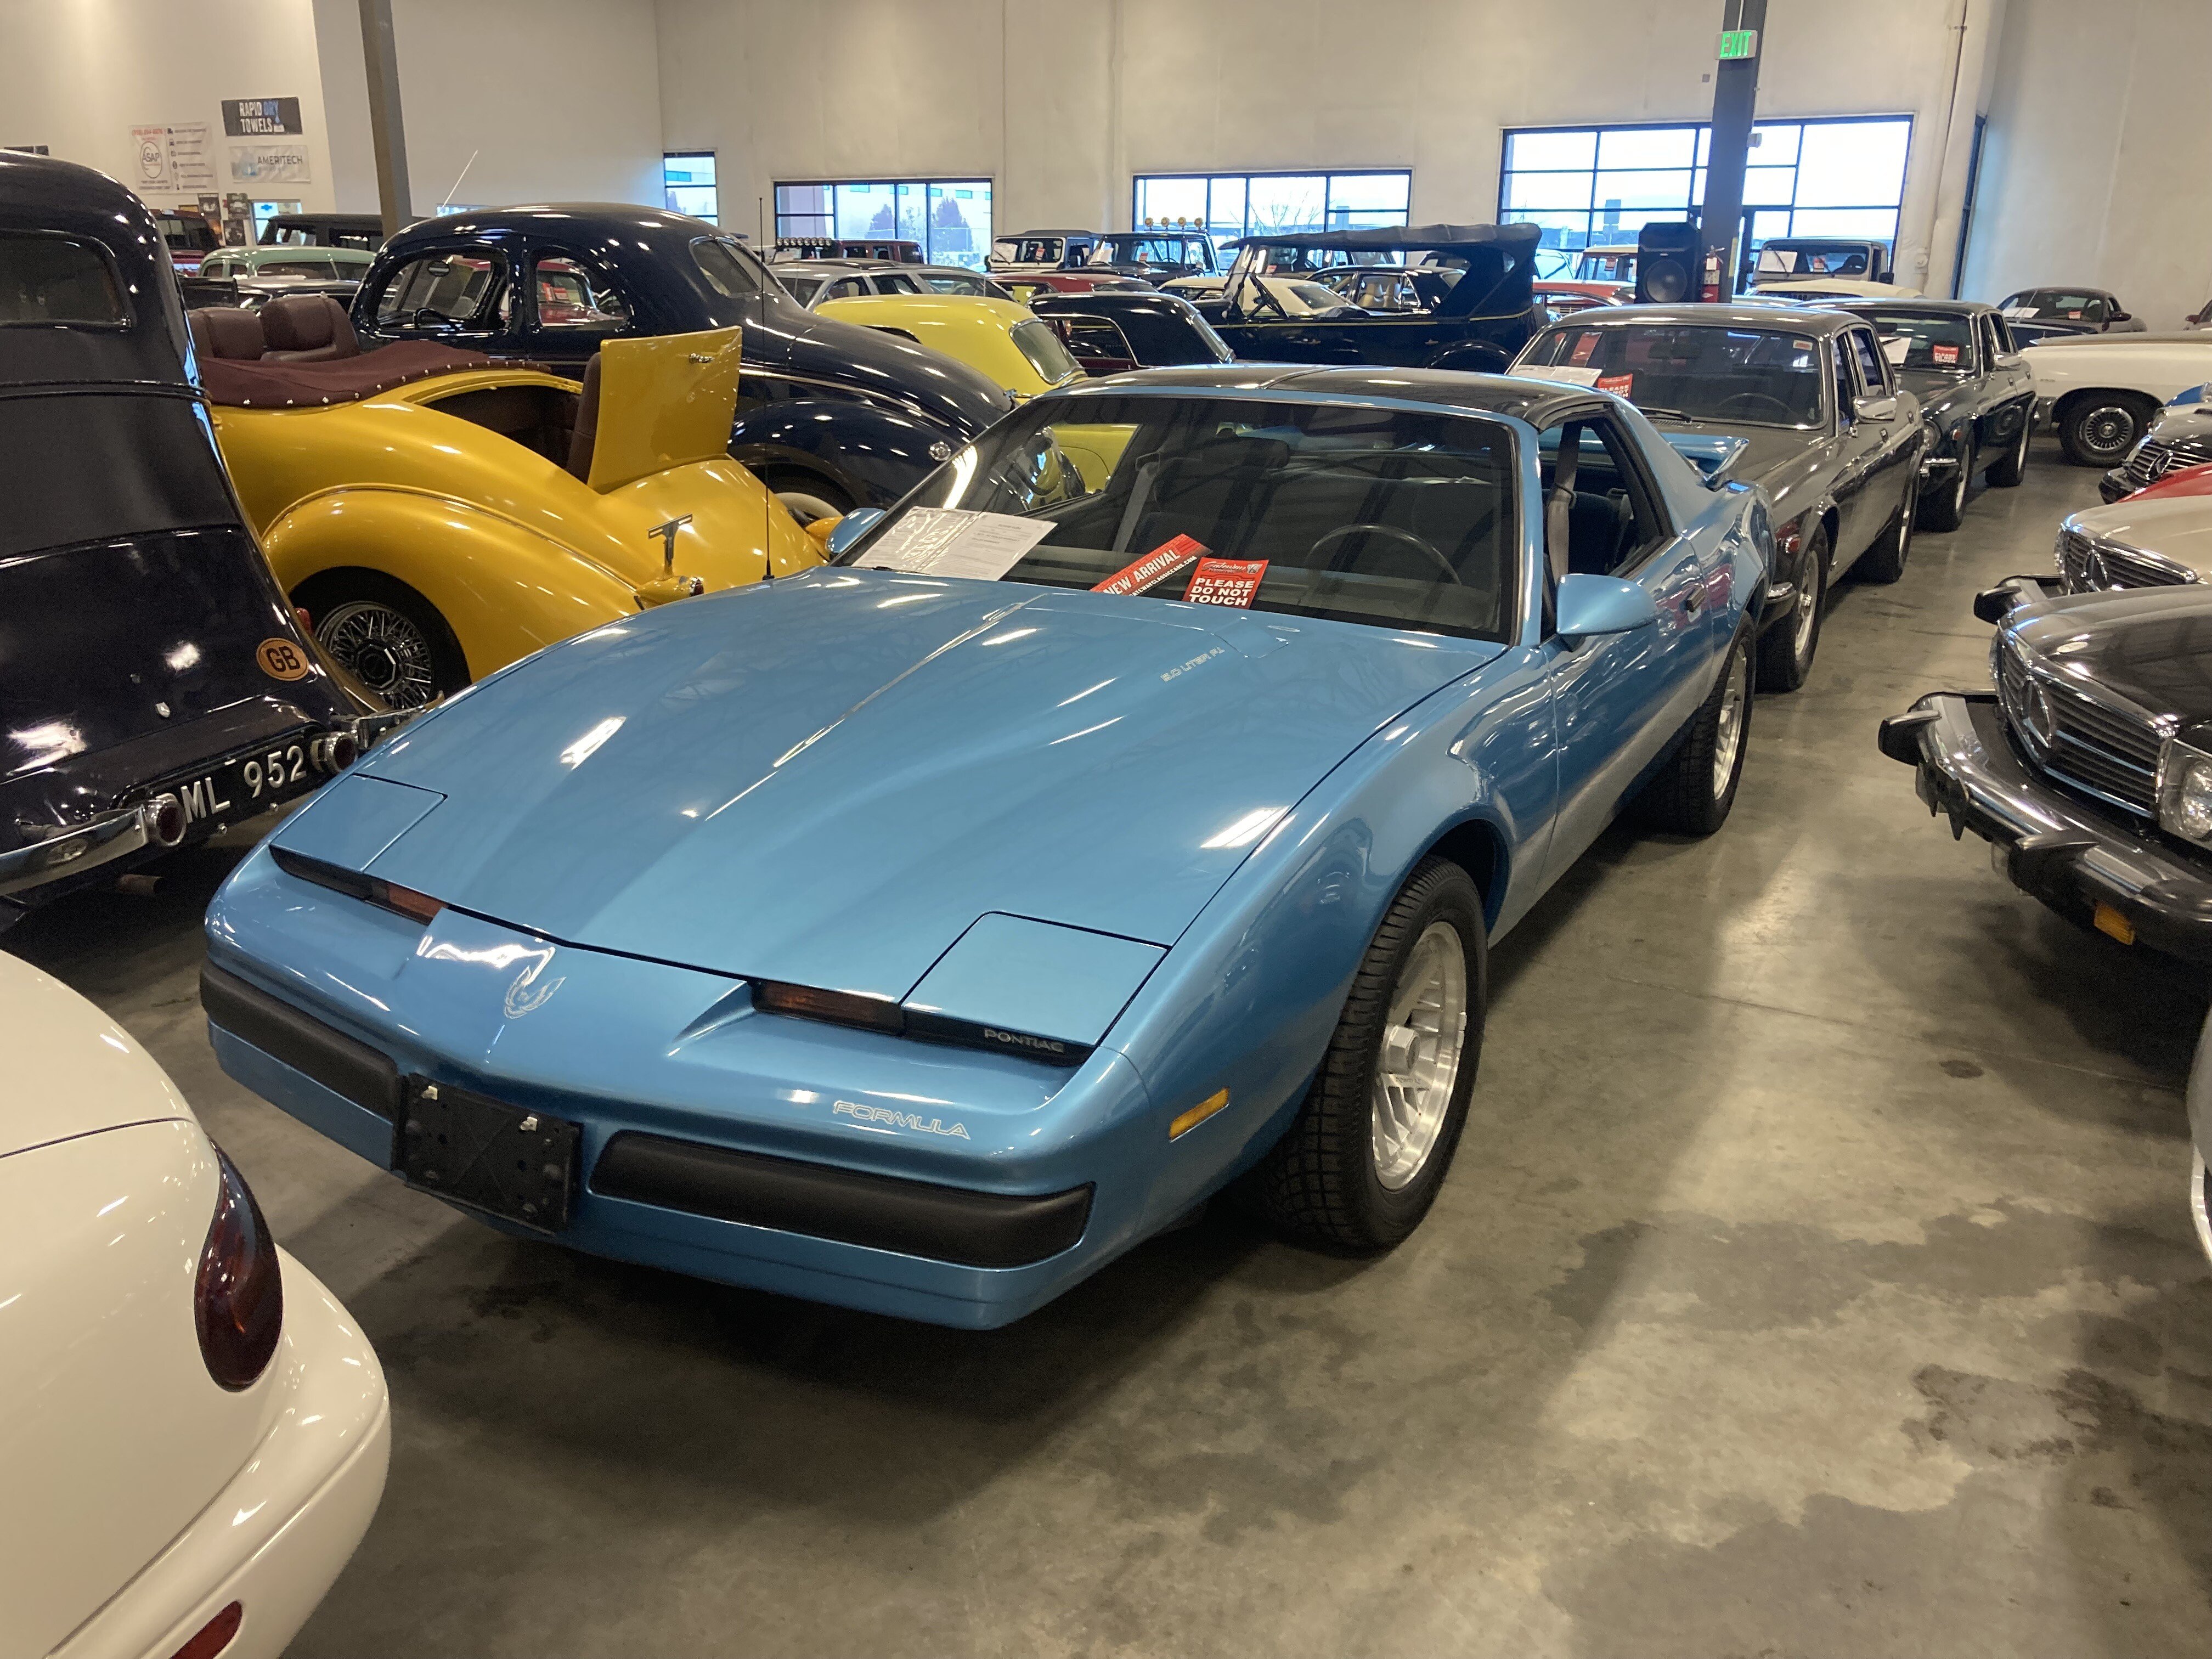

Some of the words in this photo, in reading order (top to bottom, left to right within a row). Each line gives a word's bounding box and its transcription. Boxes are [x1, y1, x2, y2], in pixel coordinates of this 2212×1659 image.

[1720, 31, 1752, 58] EXIT
[239, 101, 263, 117] RAPID
[240, 117, 273, 133] TOWELS
[257, 156, 303, 165] AMERITECH
[1103, 576, 1131, 594] NEW
[1133, 549, 1181, 583] ARRIVAL
[1191, 585, 1214, 595] DO
[1218, 588, 1252, 597] NOT
[1195, 578, 1255, 588] PLEASE
[1189, 594, 1248, 606] TOUCH
[266, 646, 301, 672] GB
[1180, 653, 1212, 672] LITER
[156, 777, 231, 823] ML
[244, 746, 307, 798] 952
[984, 1028, 1065, 1053] PONTIAC
[833, 1100, 971, 1140] FORMULA
